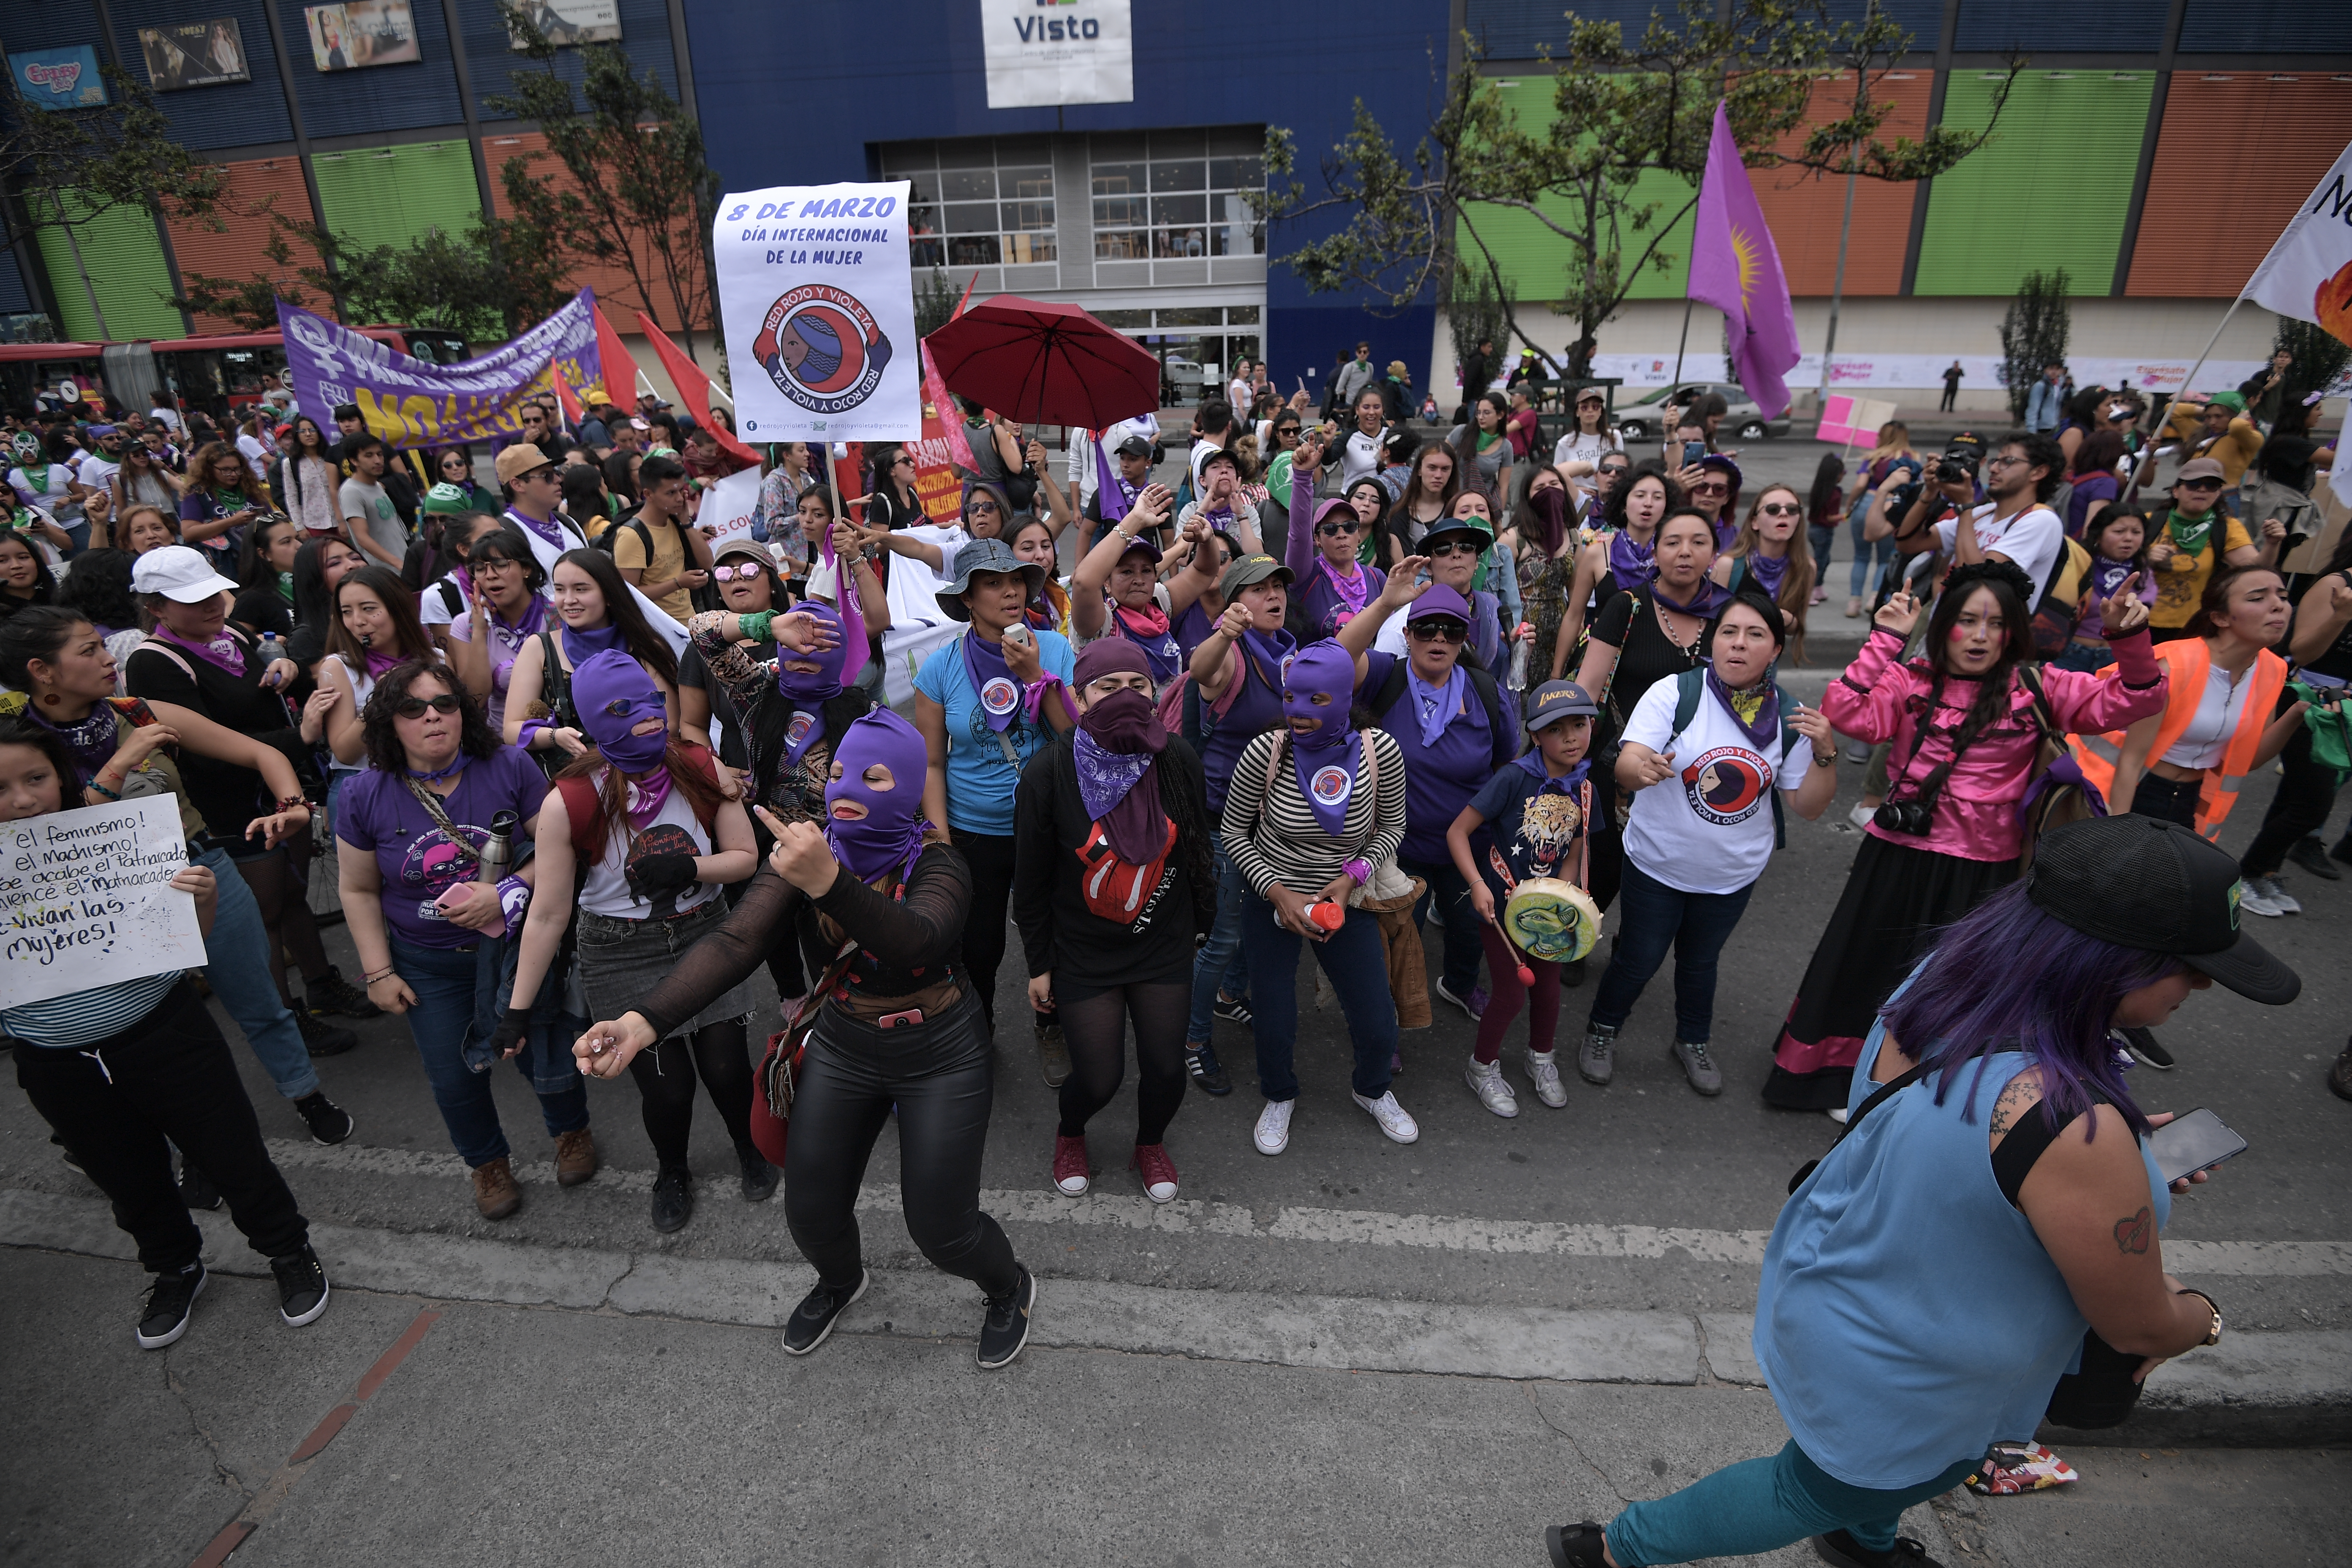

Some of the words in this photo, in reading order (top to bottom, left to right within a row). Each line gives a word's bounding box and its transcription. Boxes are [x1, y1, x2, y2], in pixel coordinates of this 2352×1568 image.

[1014, 15, 1099, 42] Visto
[26, 64, 80, 83] Crazy
[727, 204, 750, 221] 8
[756, 201, 795, 219] DE
[799, 196, 897, 218] MARZO
[741, 225, 766, 242] DÍA
[771, 228, 889, 243] INTERNACIONAL
[766, 250, 785, 264] DE
[789, 250, 807, 264] LA
[812, 250, 863, 265] MUJER
[765, 306, 784, 332] RED
[780, 288, 813, 310] ROJO
[816, 287, 825, 298] Y
[829, 289, 874, 332] VIOLETA
[773, 368, 817, 410] VIOLETA
[860, 368, 879, 394] RED
[819, 400, 829, 411] Y
[831, 393, 865, 411] ROJO
[355, 387, 441, 448] NO
[1538, 689, 1578, 709] LAKERS
[1693, 754, 1711, 769] RED
[1710, 747, 1734, 758] ROJO
[1737, 748, 1743, 756] Y
[1745, 751, 1772, 781] VIOLETA
[1688, 789, 1712, 822] VIOLETA
[1746, 801, 1760, 816] RED
[16, 828, 38, 849] el
[46, 811, 146, 845] feminismo!
[1713, 816, 1720, 824] Y
[1722, 814, 1746, 824] ROJO
[15, 852, 37, 871] el
[44, 831, 139, 865] Machismo!
[407, 843, 416, 853] POR
[416, 835, 426, 843] UNA
[32, 864, 90, 884] acabe
[95, 860, 111, 873] el
[66, 880, 85, 896] el
[82, 898, 125, 918] las
[7, 920, 117, 966] mujeres!
